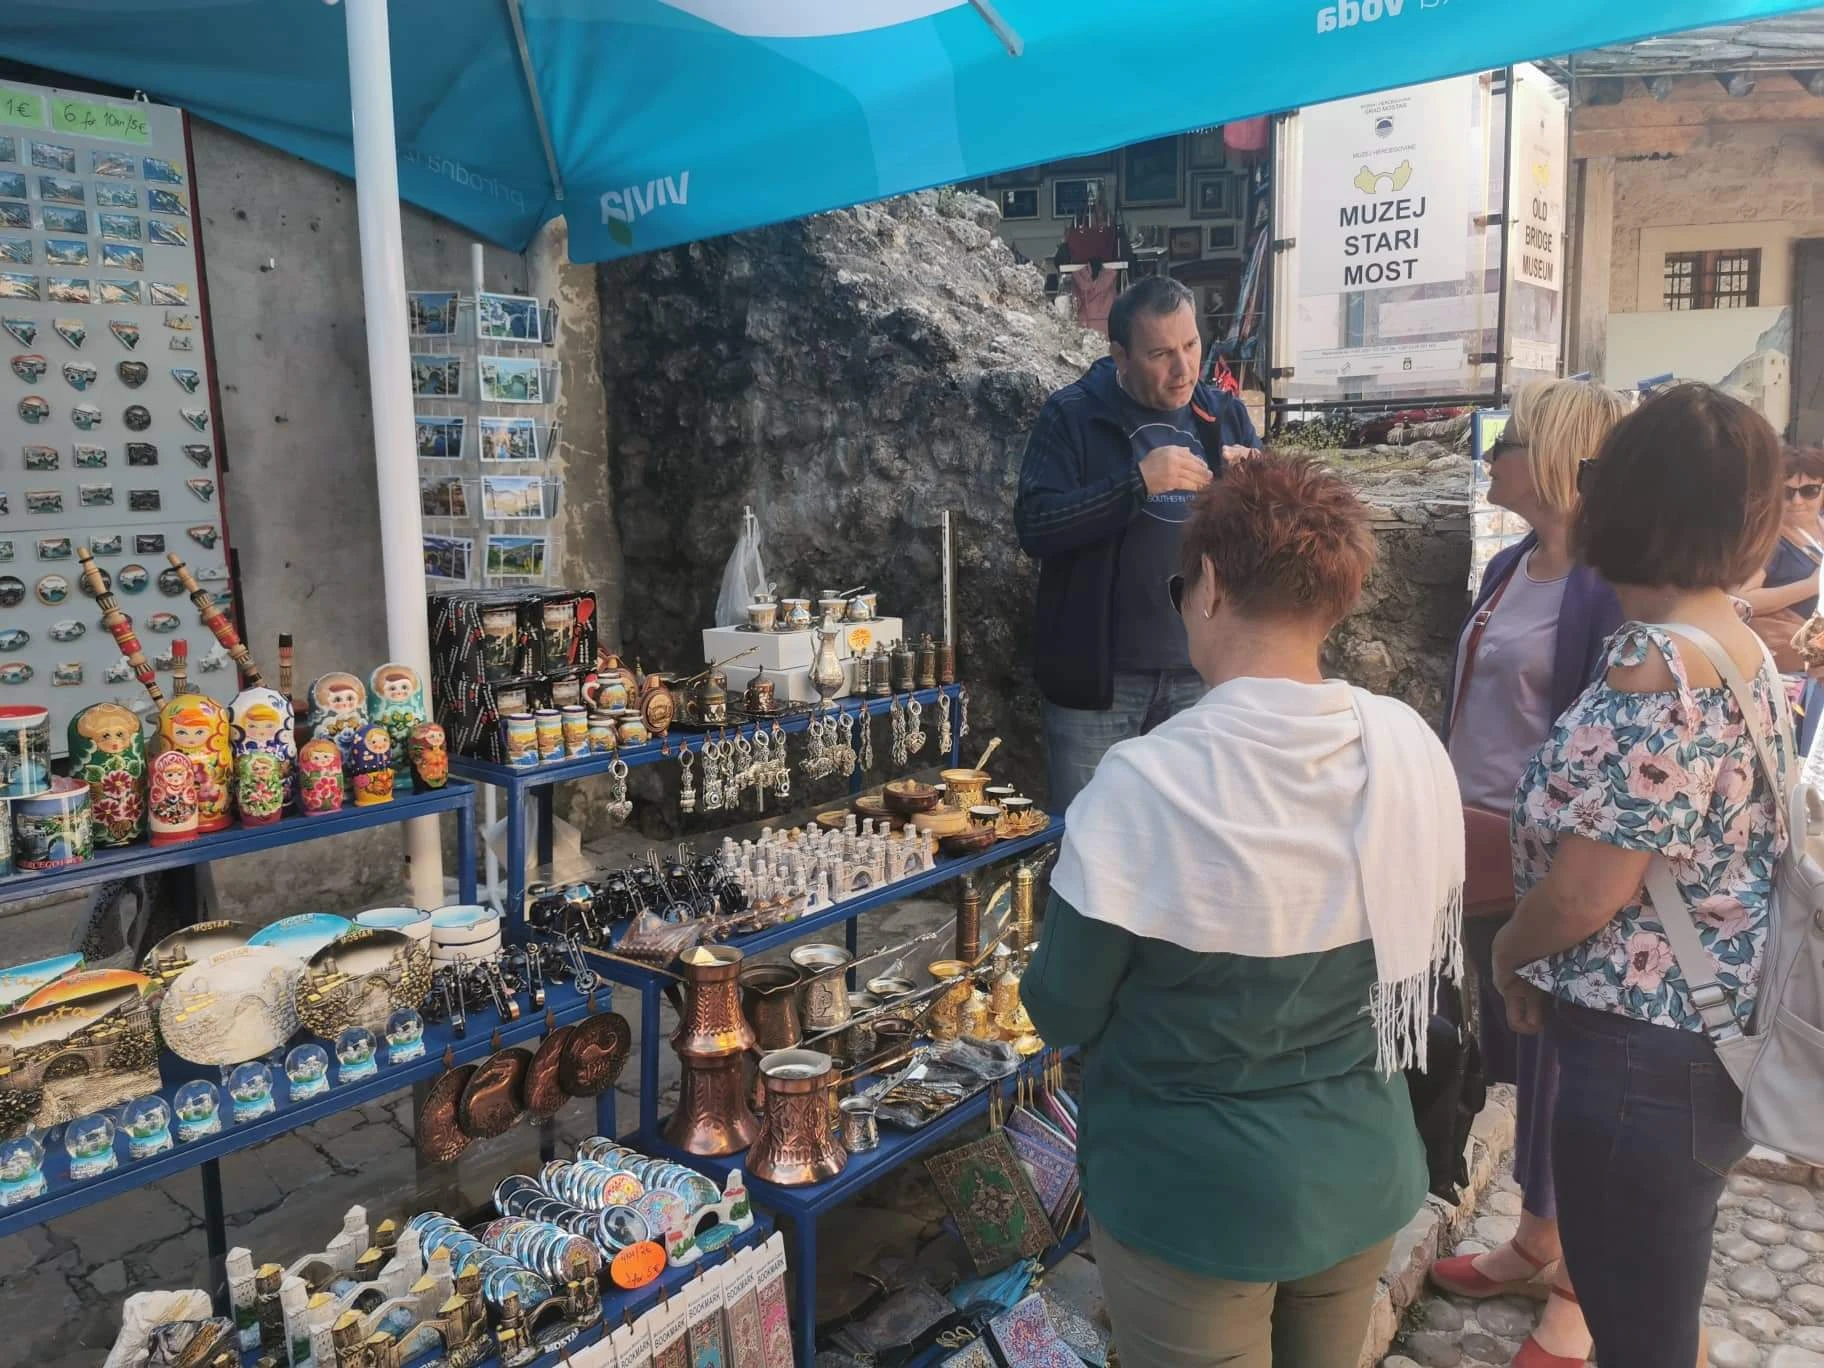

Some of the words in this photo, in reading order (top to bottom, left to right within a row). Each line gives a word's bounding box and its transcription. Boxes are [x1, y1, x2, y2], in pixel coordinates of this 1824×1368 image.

[63, 103, 77, 122] 6
[1340, 196, 1426, 227] MUZEJ
[1532, 198, 1548, 222] OLD
[1344, 228, 1419, 256] STARI
[1525, 225, 1553, 254] BRIDGE
[1344, 259, 1418, 286] MOST
[1522, 254, 1554, 283] MUSEUM
[193, 919, 232, 933] MOSTAR
[340, 928, 374, 945] MOSTAR
[211, 947, 250, 965] MOSTAR
[757, 1257, 785, 1286] BOOKMARK
[726, 1271, 755, 1302] BOOKMARK
[688, 1292, 721, 1320] BOOKMARK
[654, 1317, 685, 1350] BOOKMARK
[620, 1339, 651, 1368] BOOKMARK
